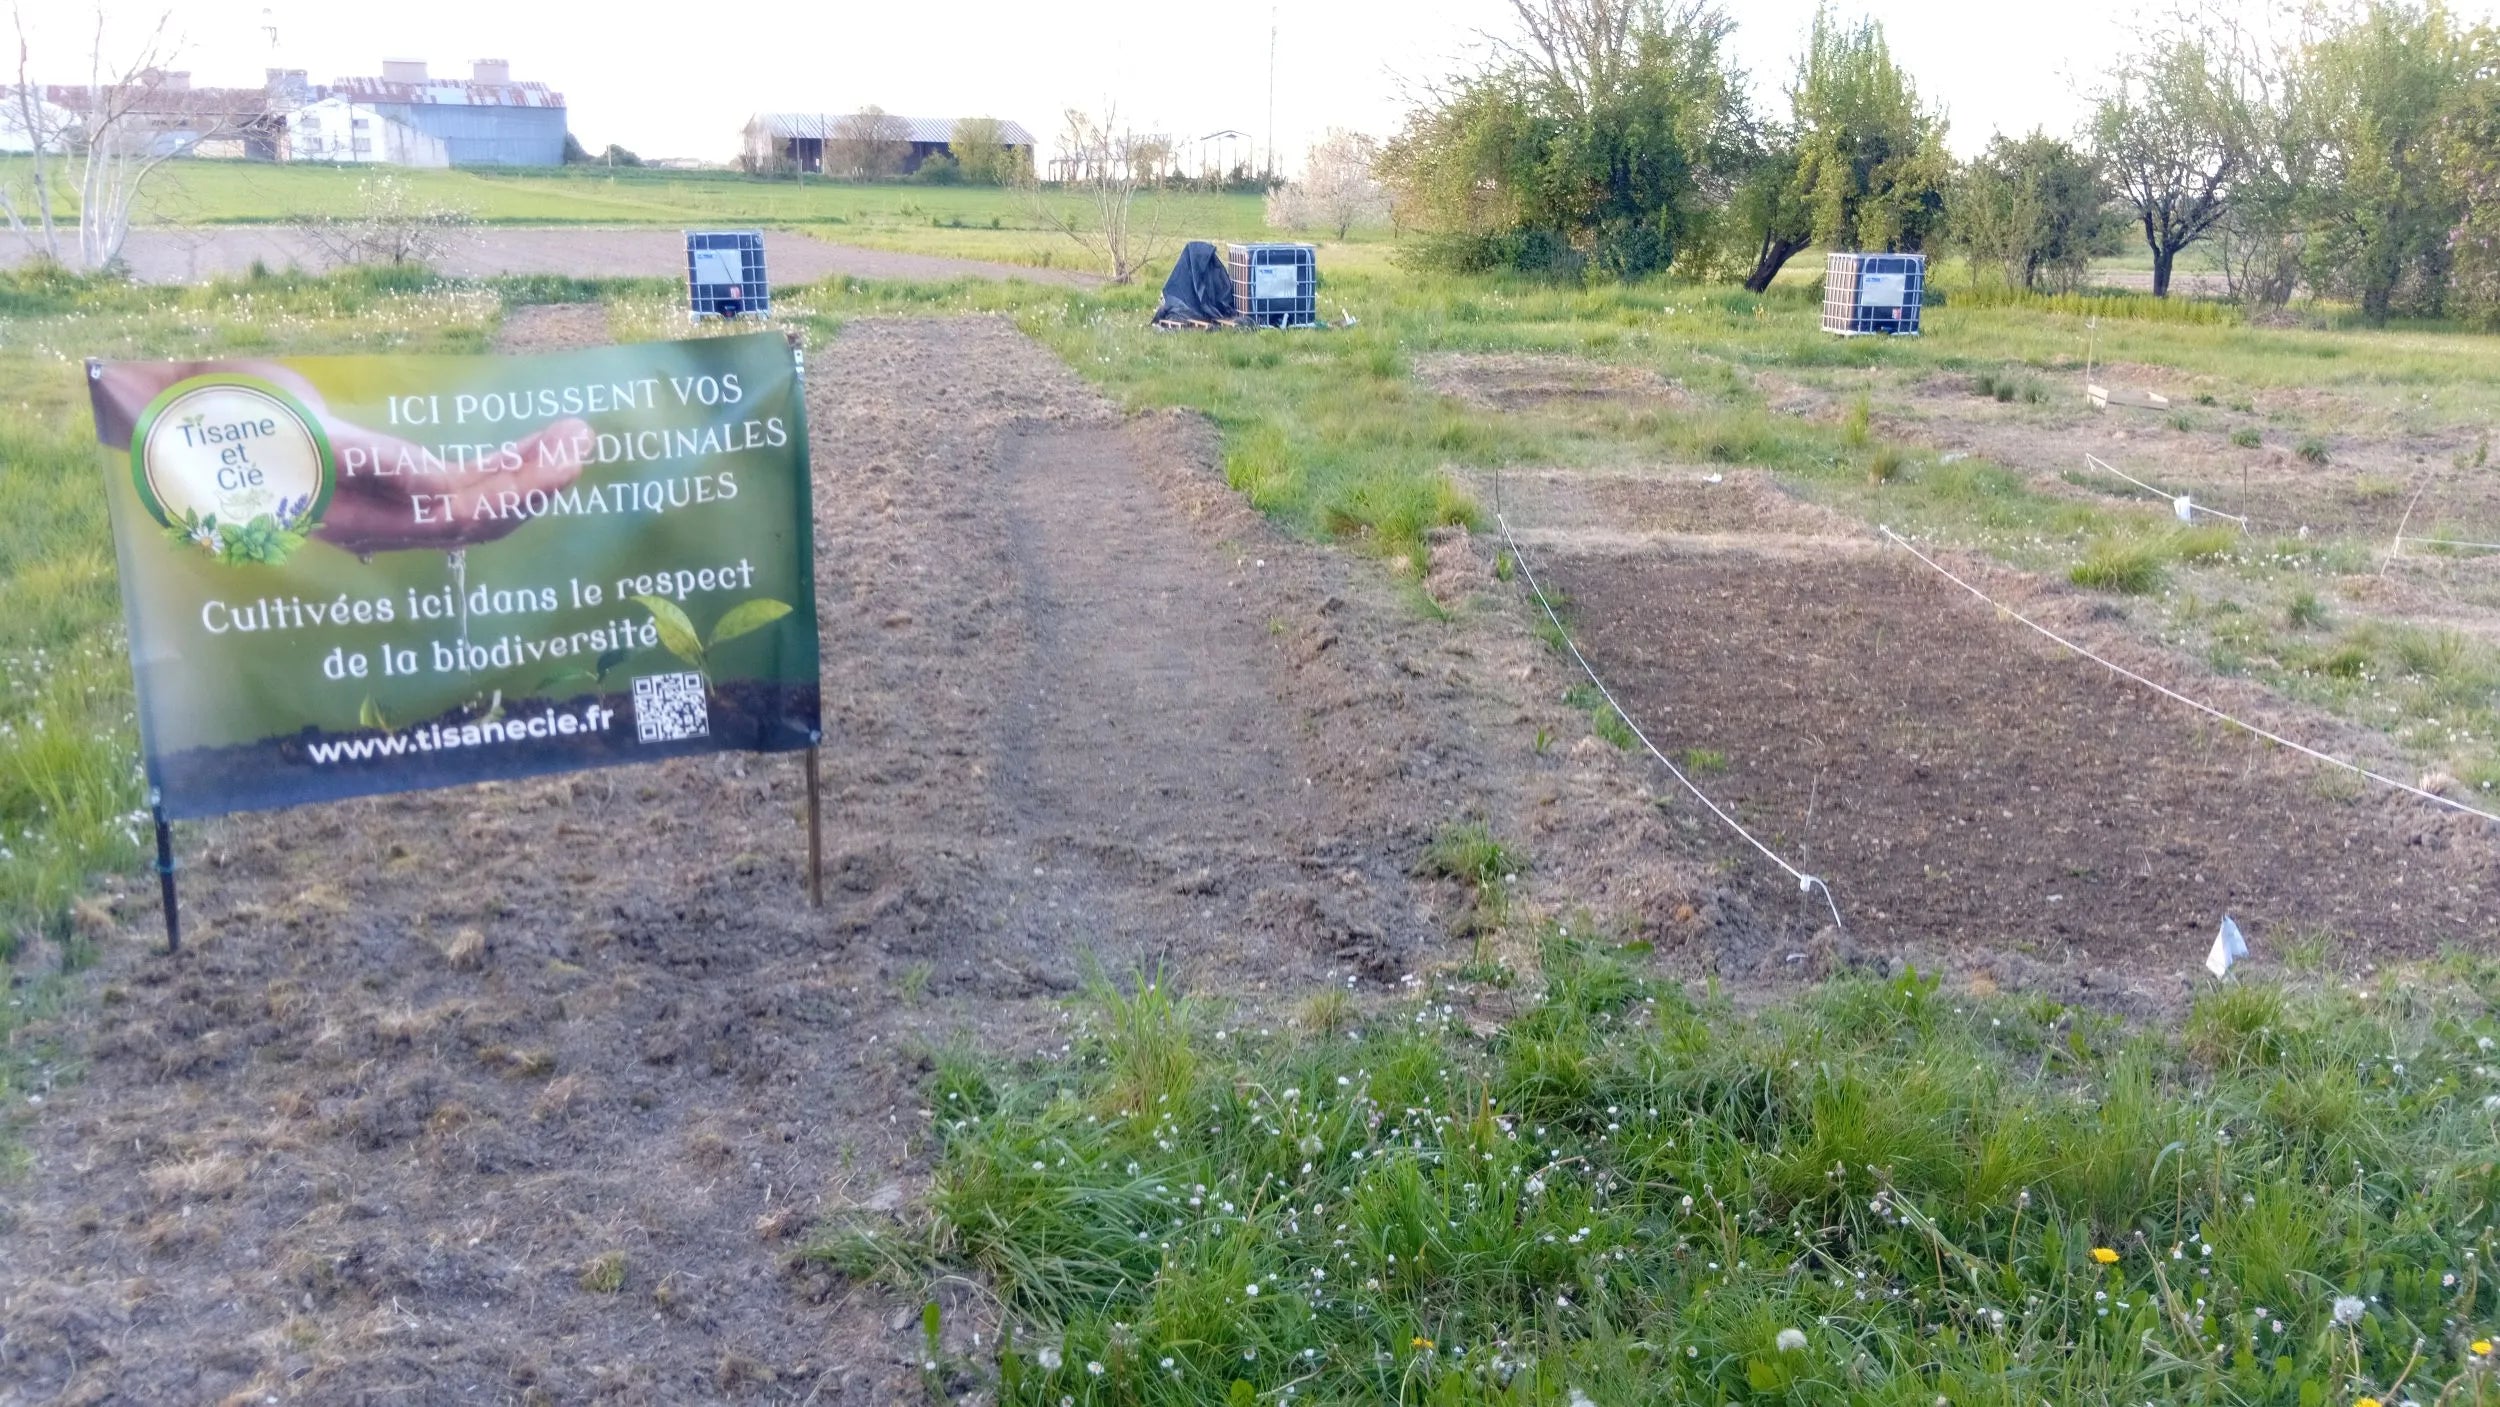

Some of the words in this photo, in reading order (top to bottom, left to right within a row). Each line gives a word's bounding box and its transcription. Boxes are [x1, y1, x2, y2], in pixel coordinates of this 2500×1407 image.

[388, 395, 440, 425] ICI
[456, 380, 660, 422] POUSSENT
[671, 373, 743, 405] VOS
[176, 414, 276, 449] Tisane
[220, 444, 249, 467] et
[343, 444, 522, 478] PLANTES
[536, 417, 789, 466] MÉDICINALES
[412, 494, 459, 524] ET
[473, 472, 739, 520] AROMATIQUES
[202, 594, 393, 634] Cultivées
[408, 588, 455, 619] ici
[468, 586, 558, 616] dans
[571, 579, 602, 609] le
[617, 557, 756, 601] respect
[323, 647, 368, 680] de
[384, 644, 418, 674] la
[432, 617, 658, 671] biodiversité
[308, 704, 615, 764] www.tisanecie.fr
